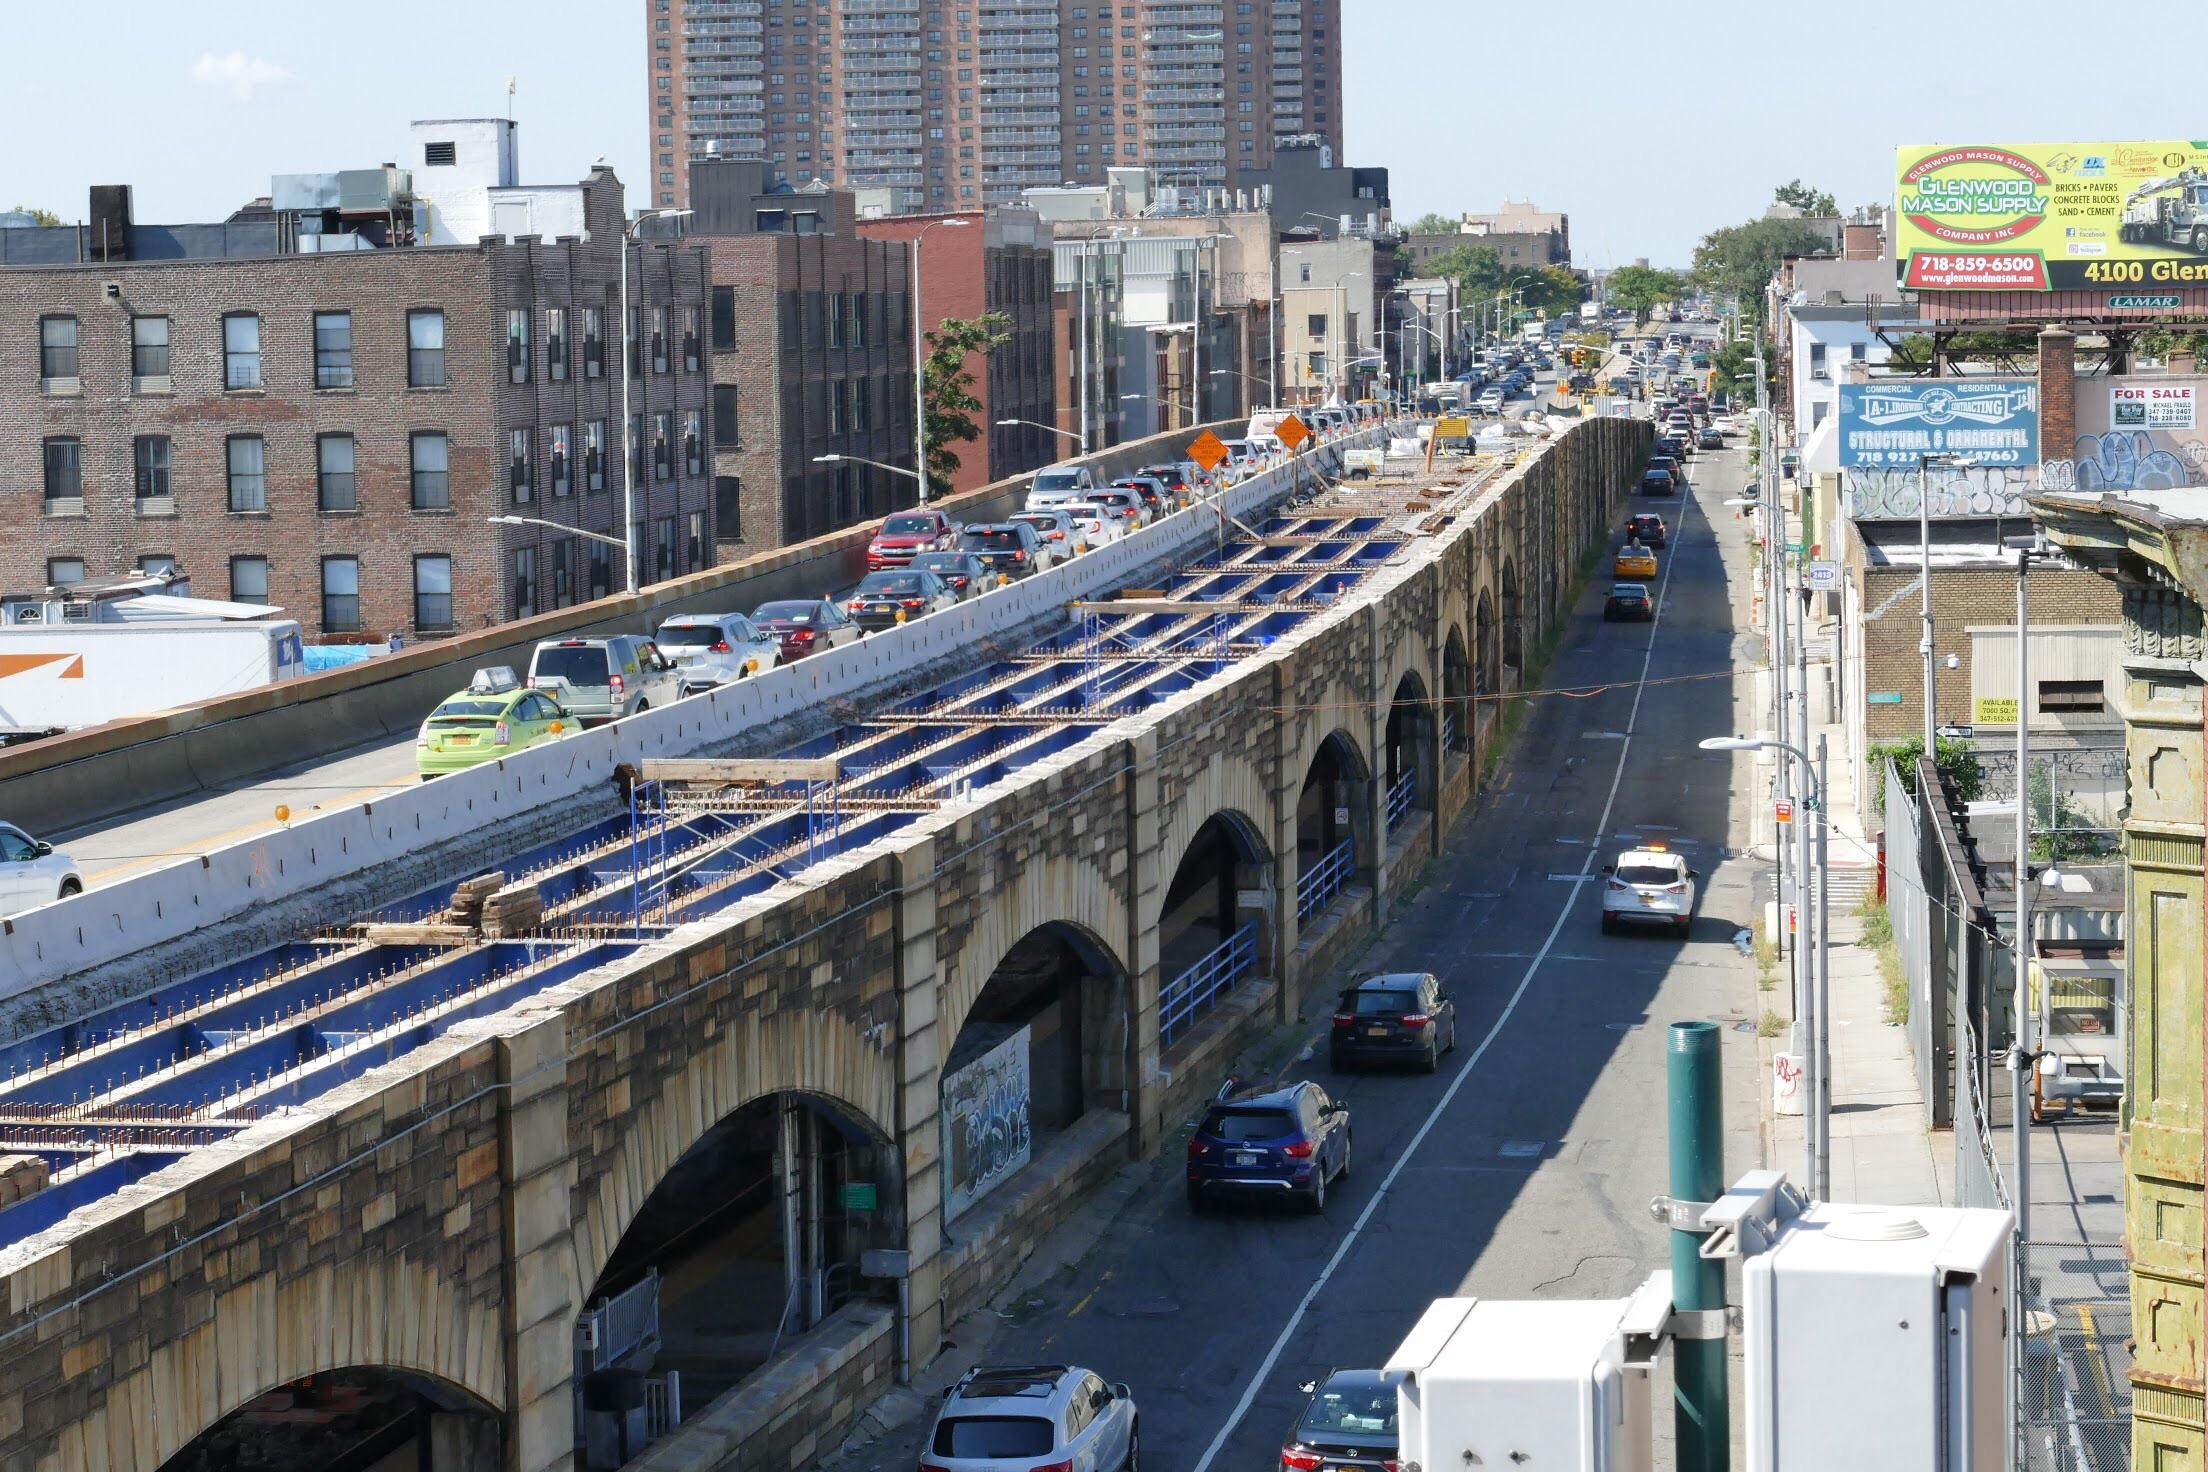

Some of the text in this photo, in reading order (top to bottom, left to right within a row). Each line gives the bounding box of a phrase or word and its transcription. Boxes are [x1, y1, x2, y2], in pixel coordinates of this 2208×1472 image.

[1909, 152, 2043, 180] GLENWOOD MASON SUPPLY
[1919, 176, 2033, 195] GLENWOOD
[2055, 183, 2118, 192] BRICKS PAVERS
[1903, 197, 2047, 212] MASON SUPPLY
[2054, 195, 2120, 204] CONCRETE BLOCKS
[2058, 207, 2115, 216] SAND CEMENT
[1936, 227, 2015, 241] COMPANY INC
[1921, 256, 2034, 271] 718-859-6500
[2084, 260, 2208, 281] 4100 Glen
[1921, 272, 2034, 285] www.glenwoodmason.com
[2114, 297, 2174, 307] LAMAR
[1865, 385, 1913, 393] COMMERCIAL
[1957, 384, 2007, 392] RESIDENTIAL
[2114, 389, 2191, 399] FOR SALE
[1849, 430, 1931, 450] STRUCTURAL
[1947, 429, 2029, 448] ORNAMENTAL
[1857, 452, 1884, 463] 718
